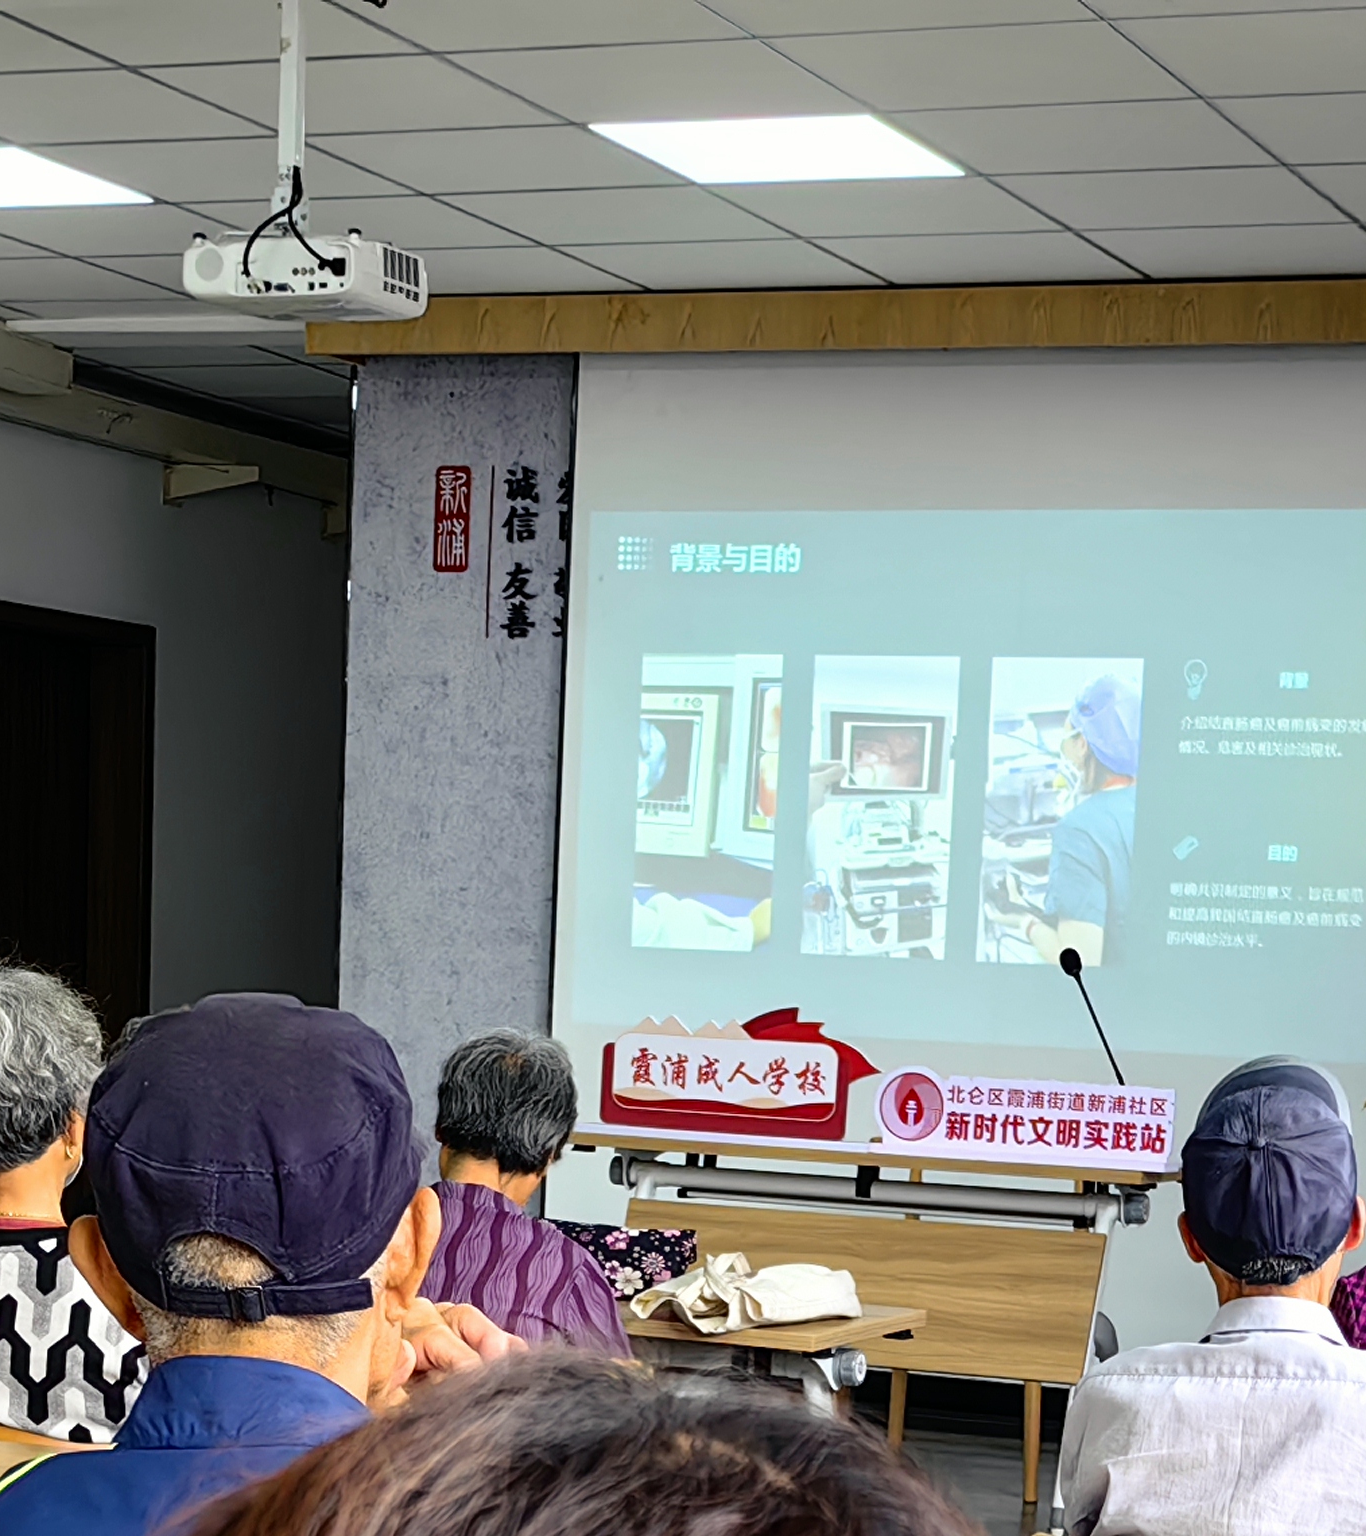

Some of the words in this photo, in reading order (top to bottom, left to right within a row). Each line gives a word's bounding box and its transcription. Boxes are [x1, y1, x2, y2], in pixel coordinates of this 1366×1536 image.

[501, 465, 539, 544] 诚信
[670, 541, 802, 574] 背景与目的
[499, 562, 537, 640] 友善
[1267, 844, 1299, 862] 目的
[629, 1046, 827, 1097] 霞浦成人学校
[946, 1085, 1169, 1118] 北仑区霞浦街道新浦社区
[944, 1111, 1167, 1155] 新时代文明实践站
